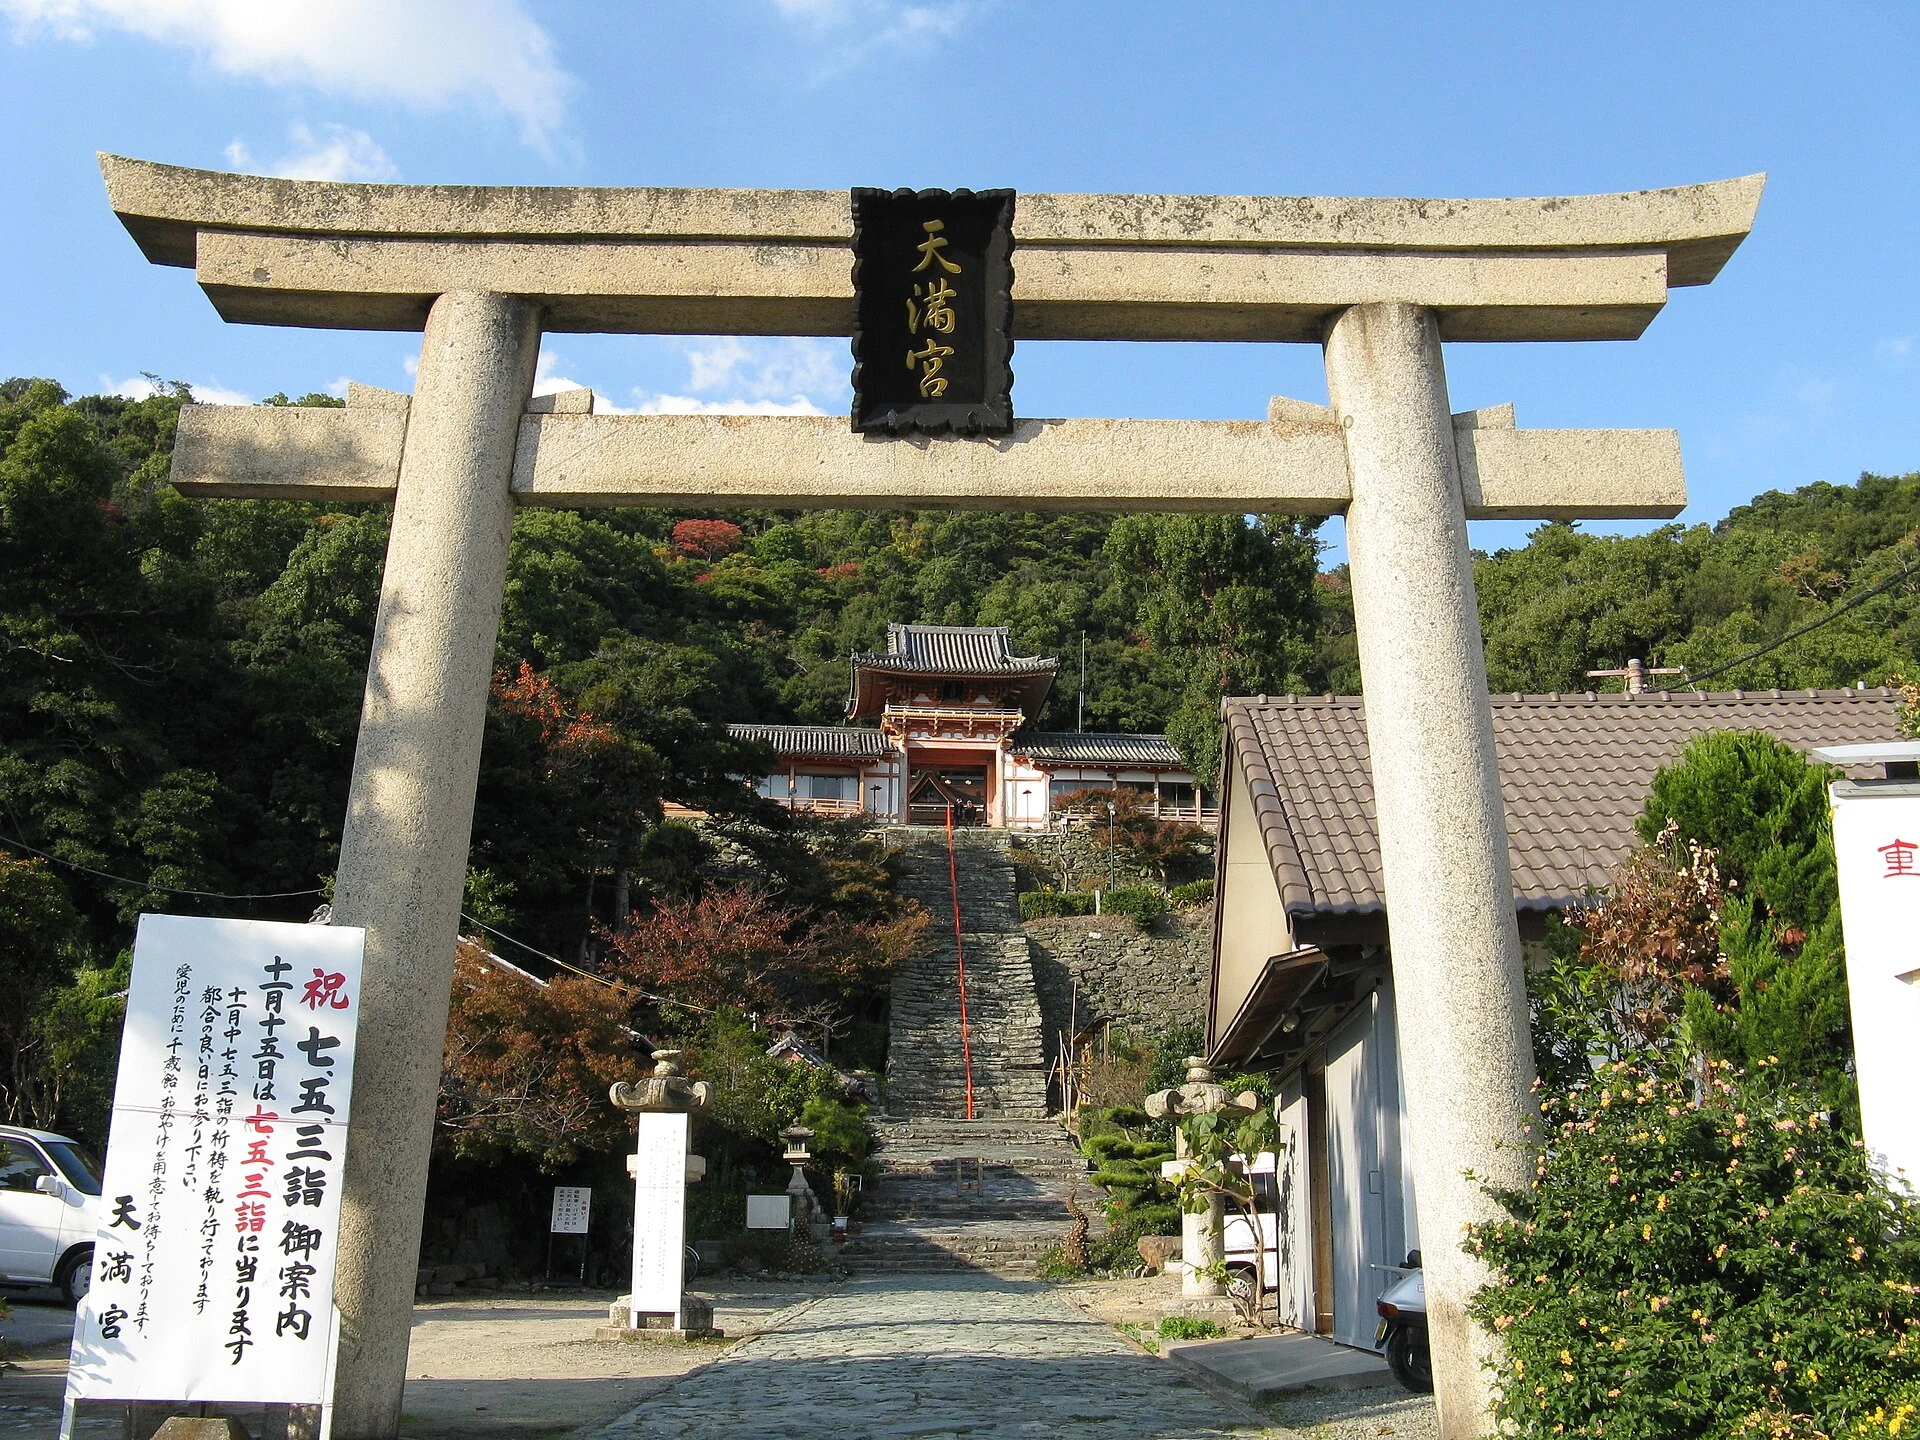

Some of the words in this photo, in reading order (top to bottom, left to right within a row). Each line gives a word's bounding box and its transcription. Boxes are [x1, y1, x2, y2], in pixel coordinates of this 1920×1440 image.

[905, 219, 962, 398] 天満宮
[98, 1194, 142, 1340] 天満宮
